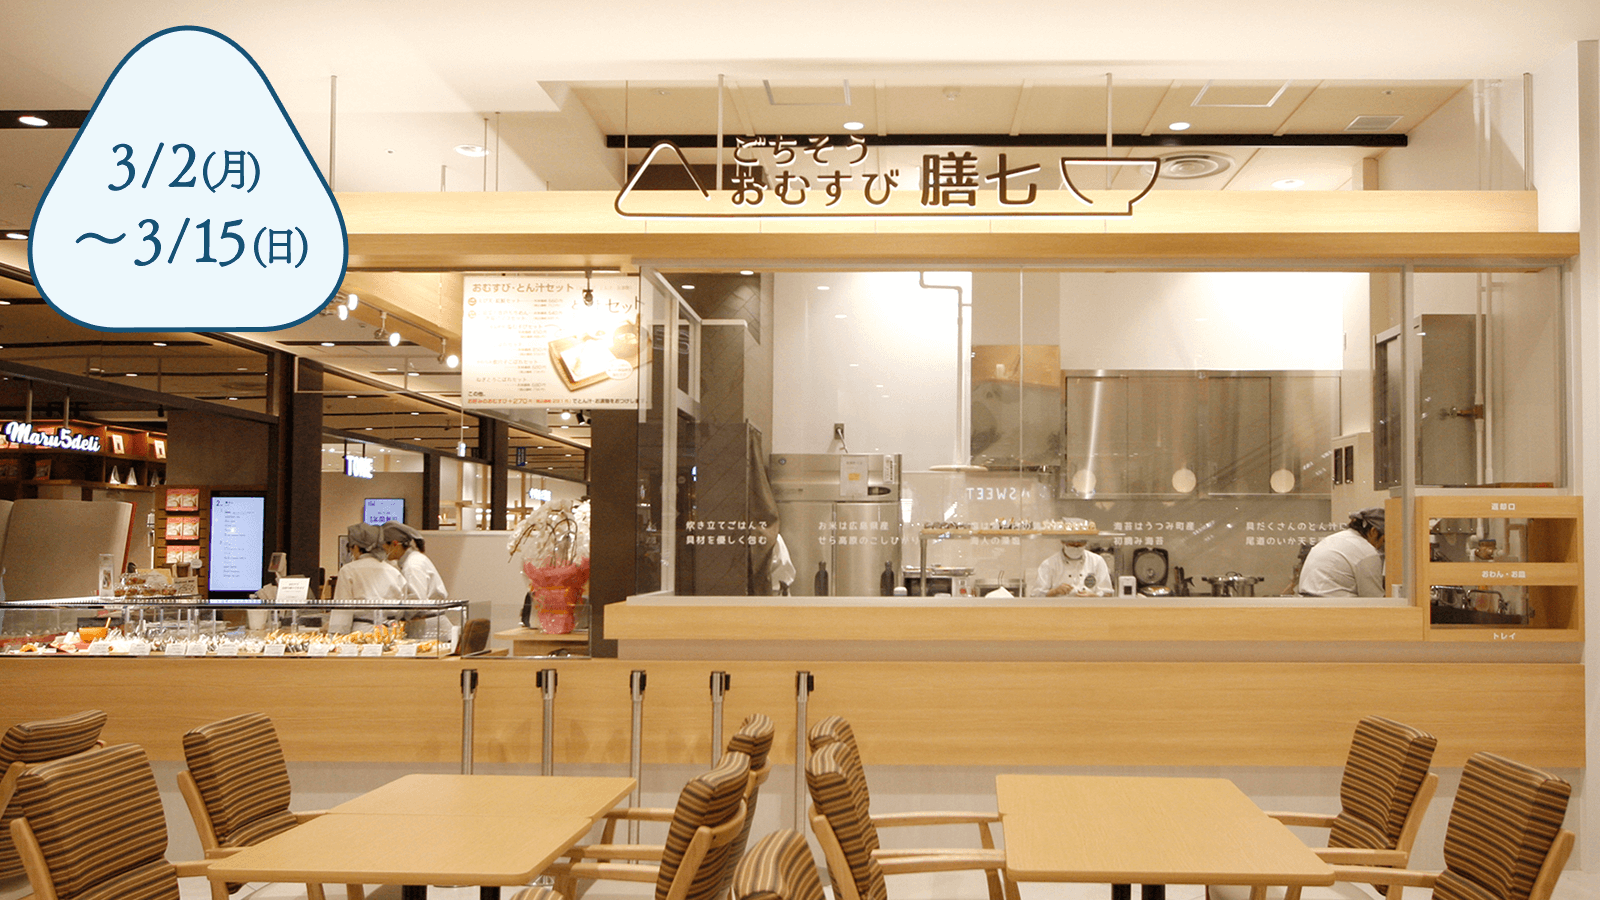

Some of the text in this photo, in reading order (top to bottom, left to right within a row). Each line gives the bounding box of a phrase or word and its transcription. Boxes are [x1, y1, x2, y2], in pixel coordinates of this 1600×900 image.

[733, 135, 870, 167] ごちそう
[730, 151, 1041, 207] おむすび 膳七
[5, 421, 101, 453] Maru5deli
[685, 520, 768, 531] 炊き立てごはんで
[685, 535, 768, 545] 具材を優しく包む
[1493, 632, 1517, 640] トレイ
